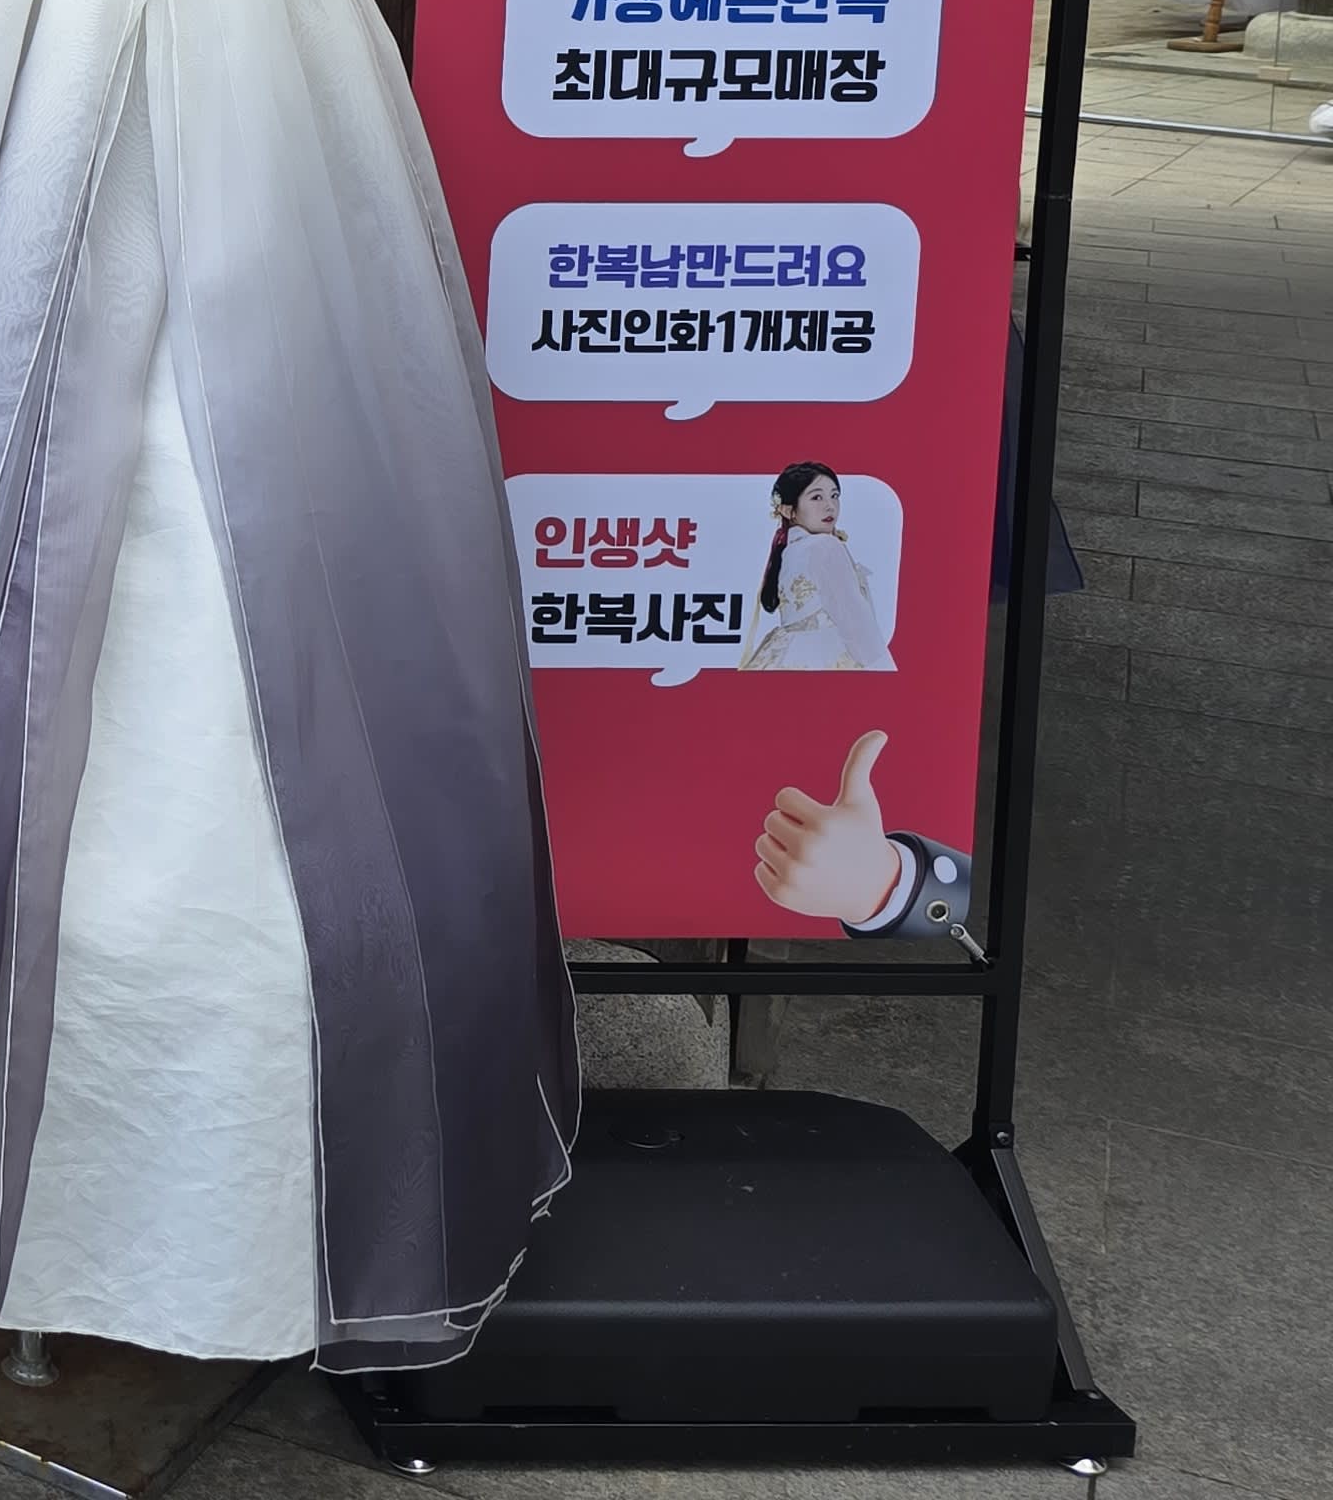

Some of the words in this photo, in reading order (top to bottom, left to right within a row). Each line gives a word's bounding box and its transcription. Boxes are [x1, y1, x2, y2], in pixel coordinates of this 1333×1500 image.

[551, 48, 888, 104] 최대규모매장
[547, 242, 868, 290] 한복남만드려요
[531, 307, 876, 355] 사진인화1개제공
[533, 515, 698, 570] 인생샷
[530, 592, 743, 645] 한복사진
